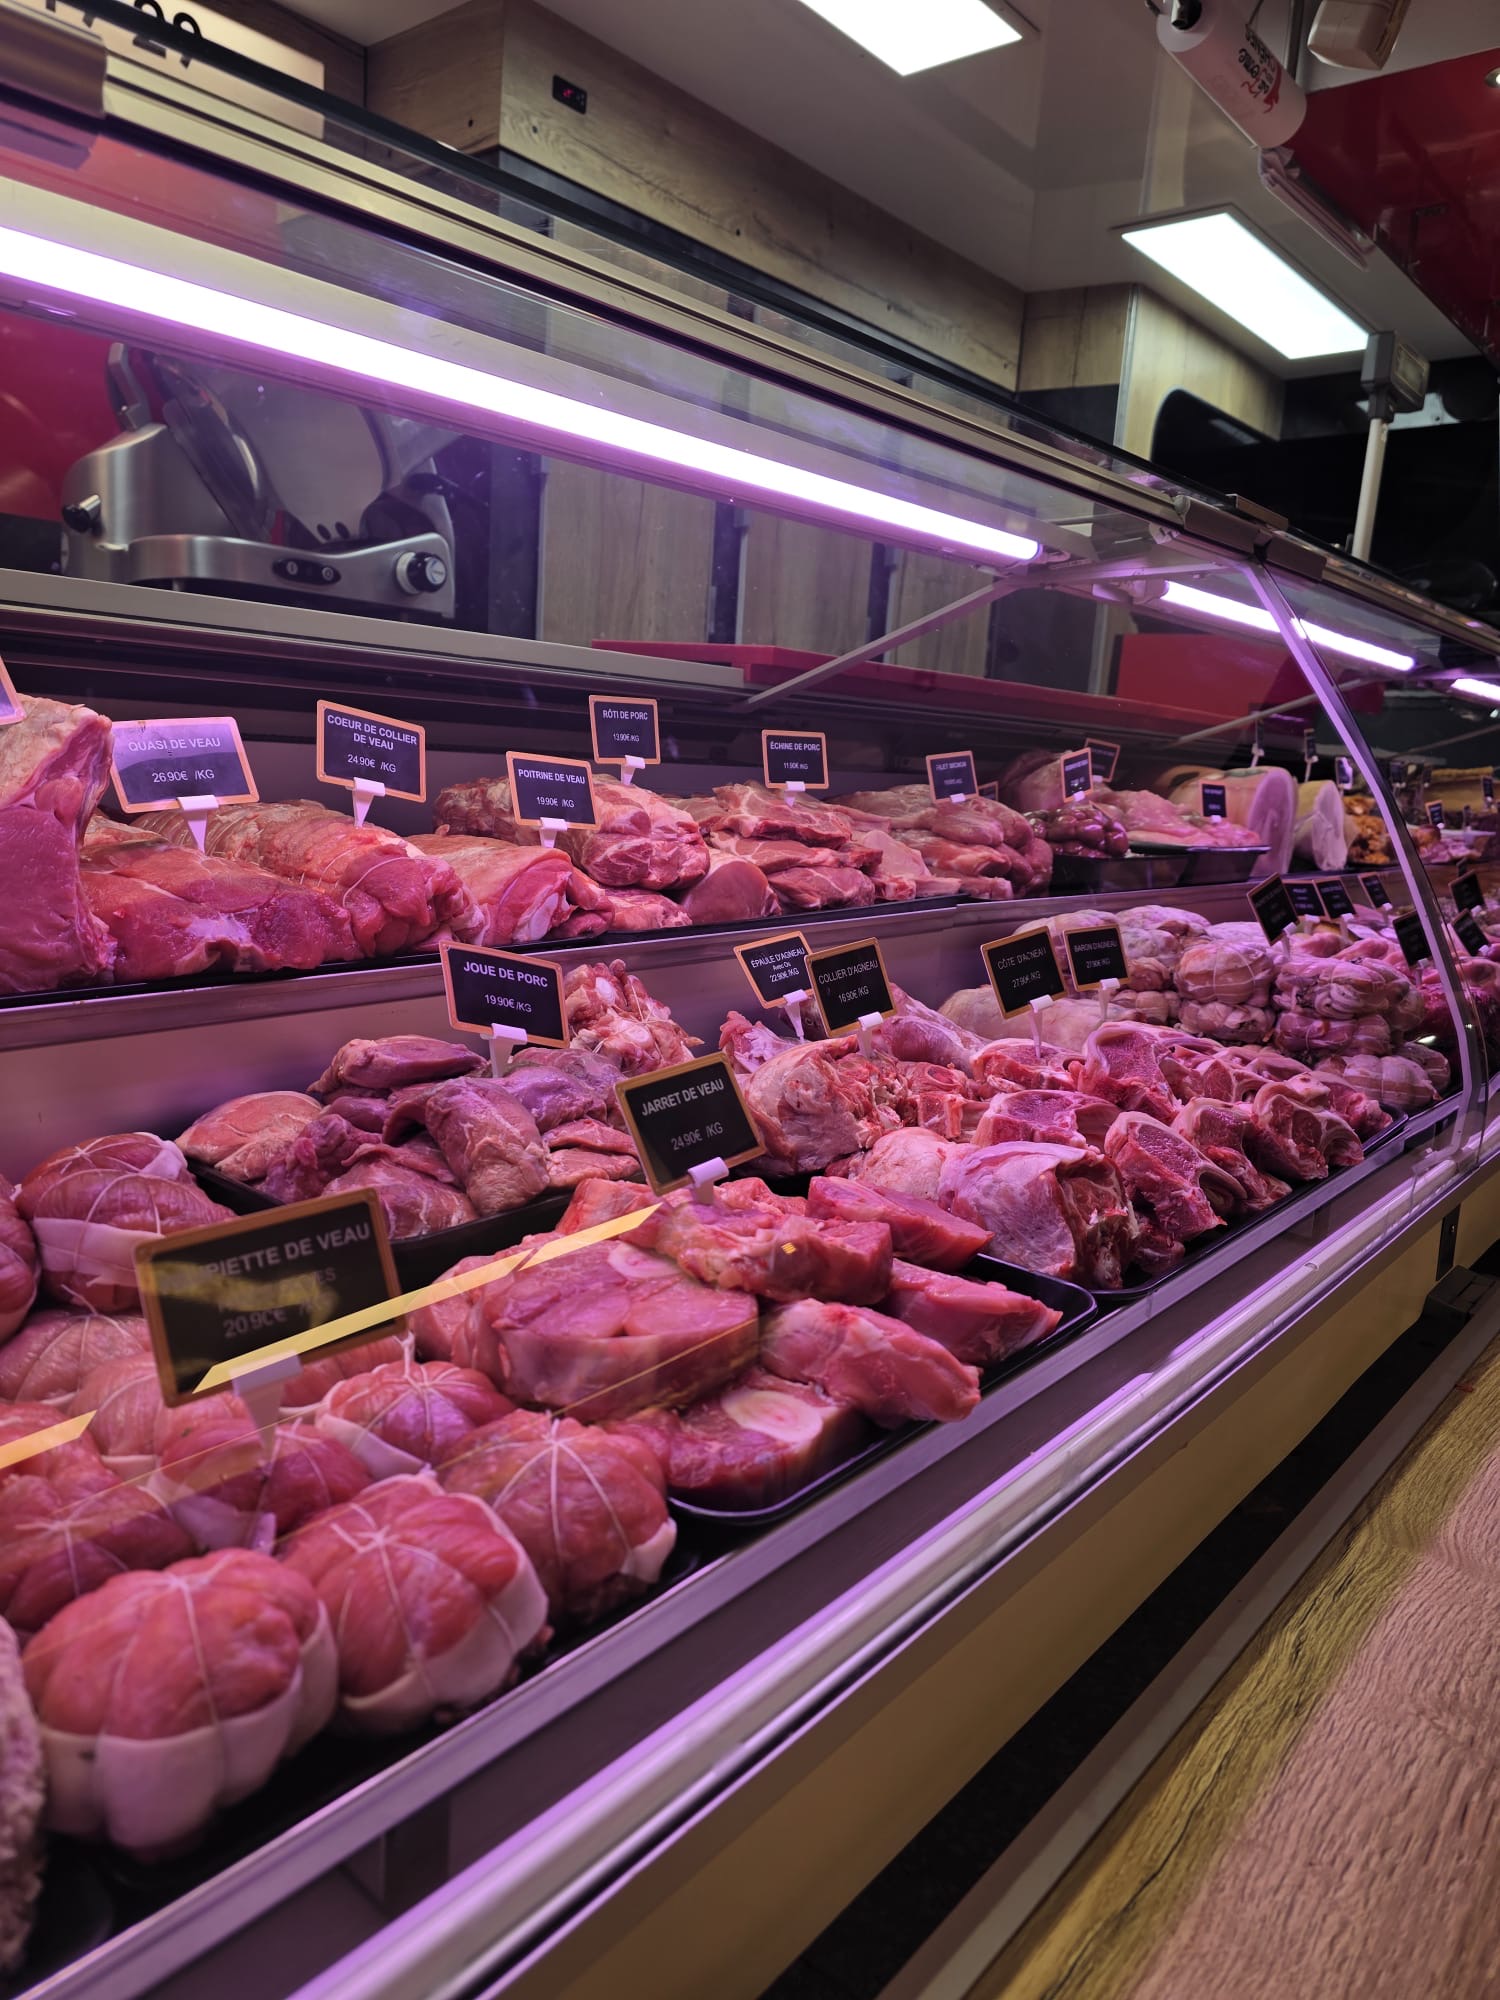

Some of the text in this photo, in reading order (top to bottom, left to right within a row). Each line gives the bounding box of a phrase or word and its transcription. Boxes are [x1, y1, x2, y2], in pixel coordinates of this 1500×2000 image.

[619, 710, 630, 720] DE
[630, 711, 649, 721] PORC
[327, 714, 417, 745] COEUR DE COLLIER
[128, 737, 221, 752] QUASI DE VEAU
[353, 733, 394, 751] DE VEAU
[794, 742, 803, 751] DE
[803, 743, 821, 751] PORC
[194, 769, 215, 781] /KG
[380, 761, 397, 773] /KG
[518, 768, 586, 785] POITRINE DE VEAU
[561, 799, 575, 808] /KG
[463, 961, 548, 988] JOUE DE PORC
[818, 959, 879, 985] COLLIER D'AGNEAU
[515, 1001, 532, 1013] /KG
[641, 1078, 724, 1116] JARRET DE VEAU
[705, 1121, 723, 1138] /KG
[284, 1237, 313, 1261] DE
[316, 1221, 371, 1250] VEAU
